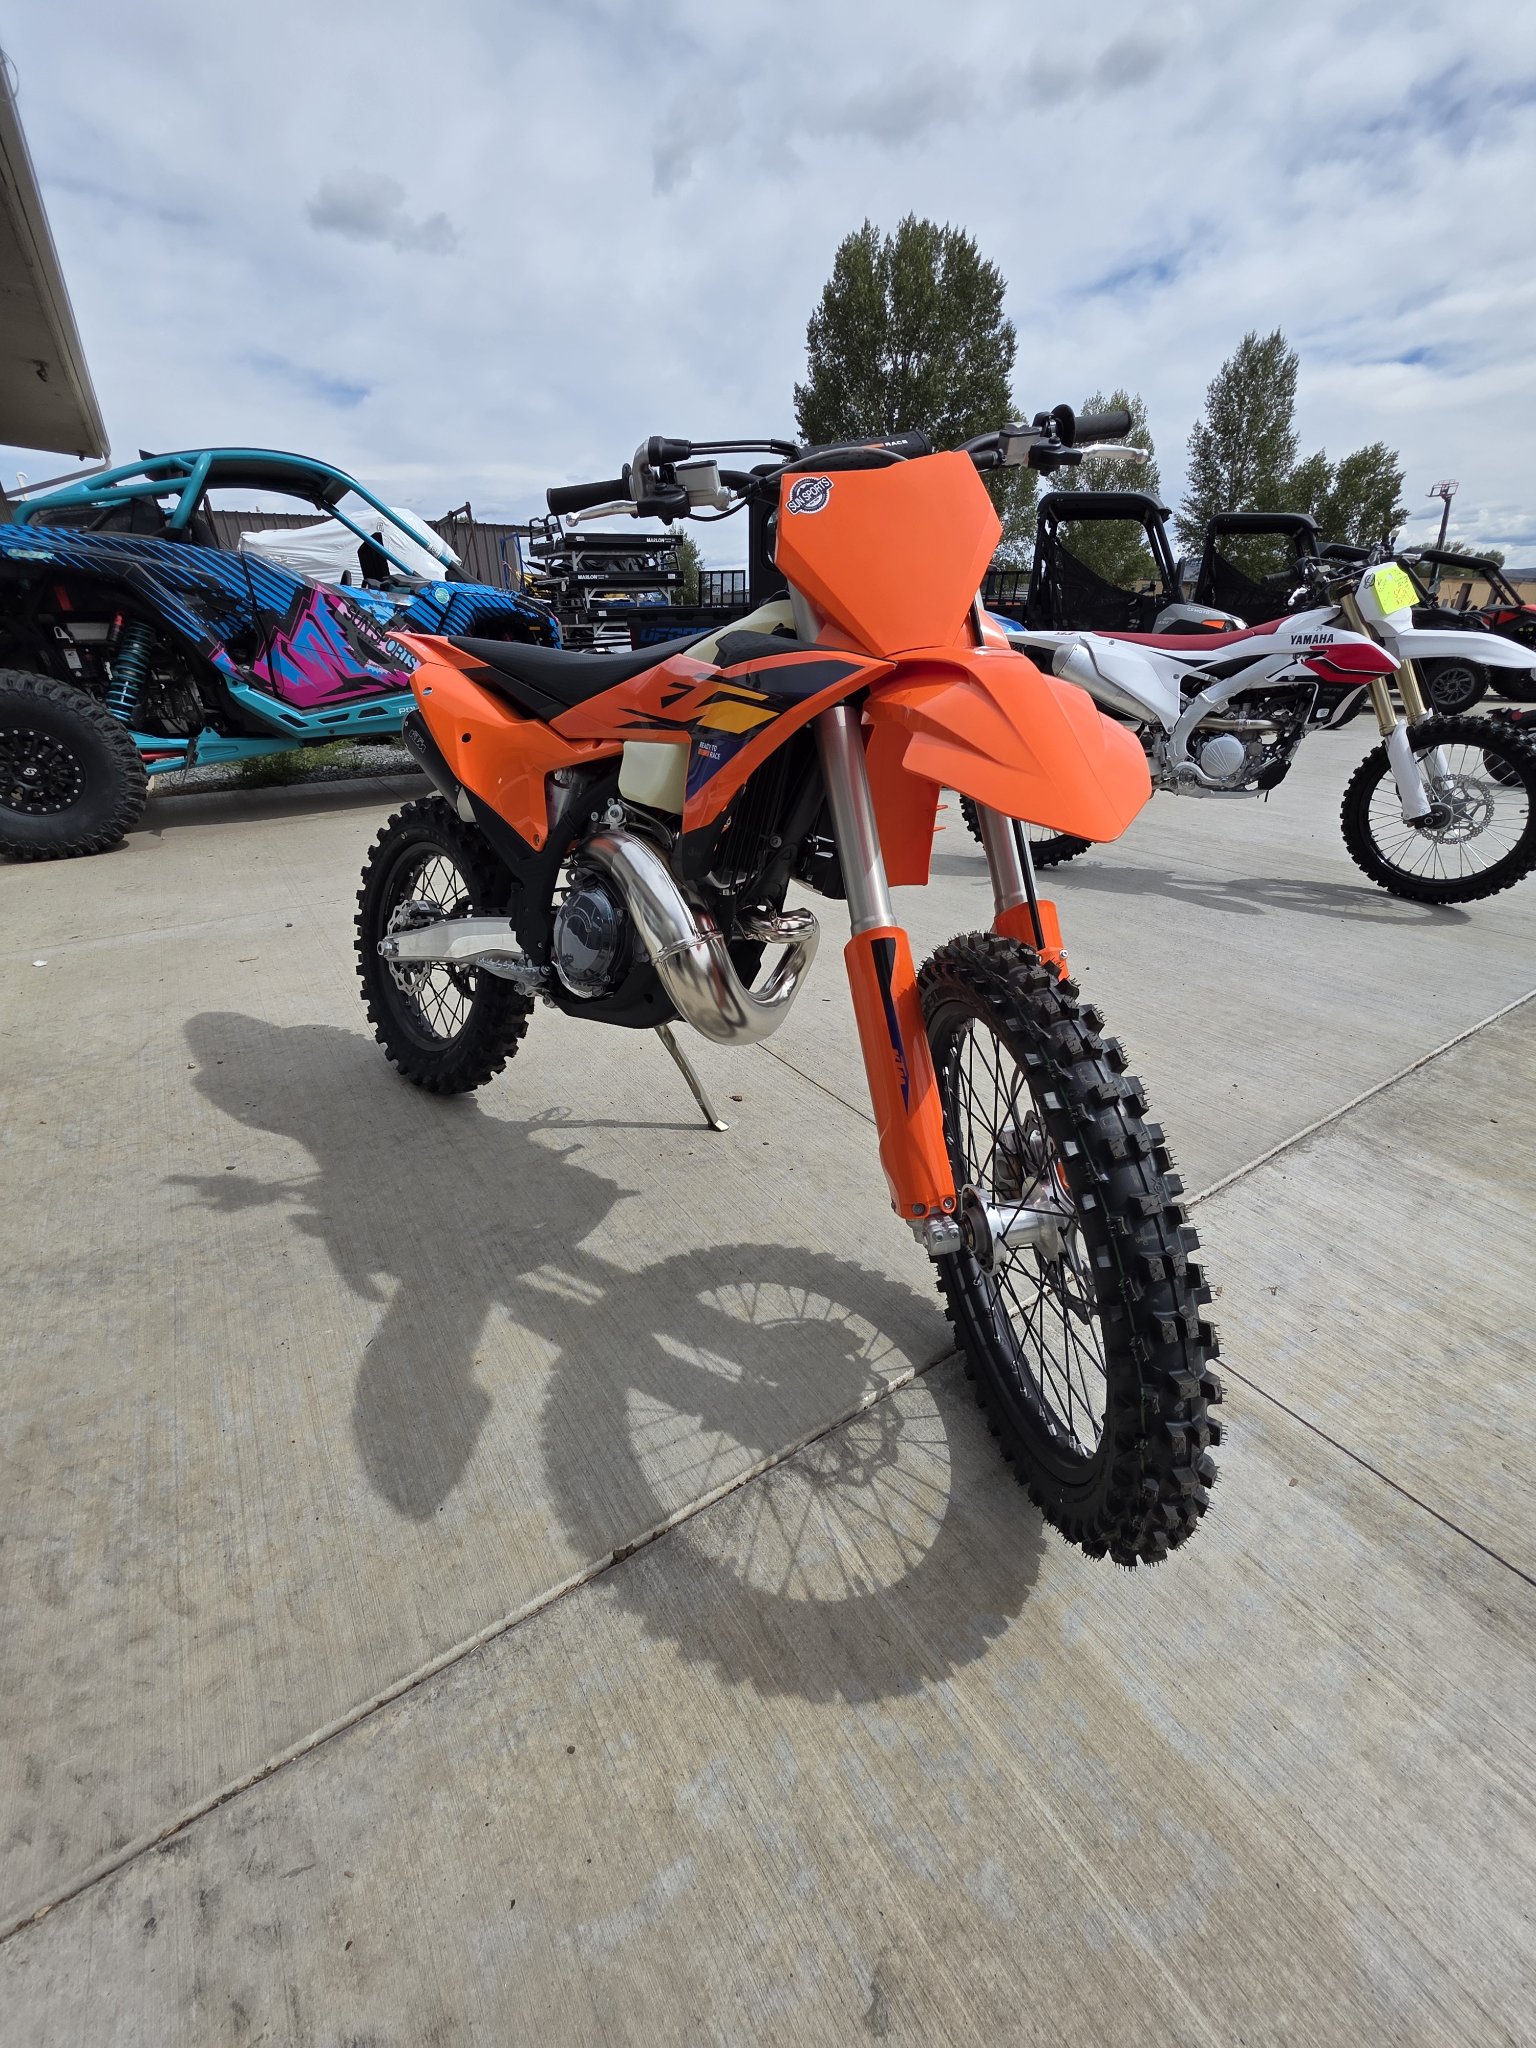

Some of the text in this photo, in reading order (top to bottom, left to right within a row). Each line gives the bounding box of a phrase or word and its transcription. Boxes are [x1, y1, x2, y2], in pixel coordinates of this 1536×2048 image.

[884, 439, 908, 447] RACE
[788, 478, 830, 511] SUN SPORTS
[343, 604, 374, 635] SUN
[1290, 633, 1334, 645] YAMAHA
[710, 751, 720, 760] RACE
